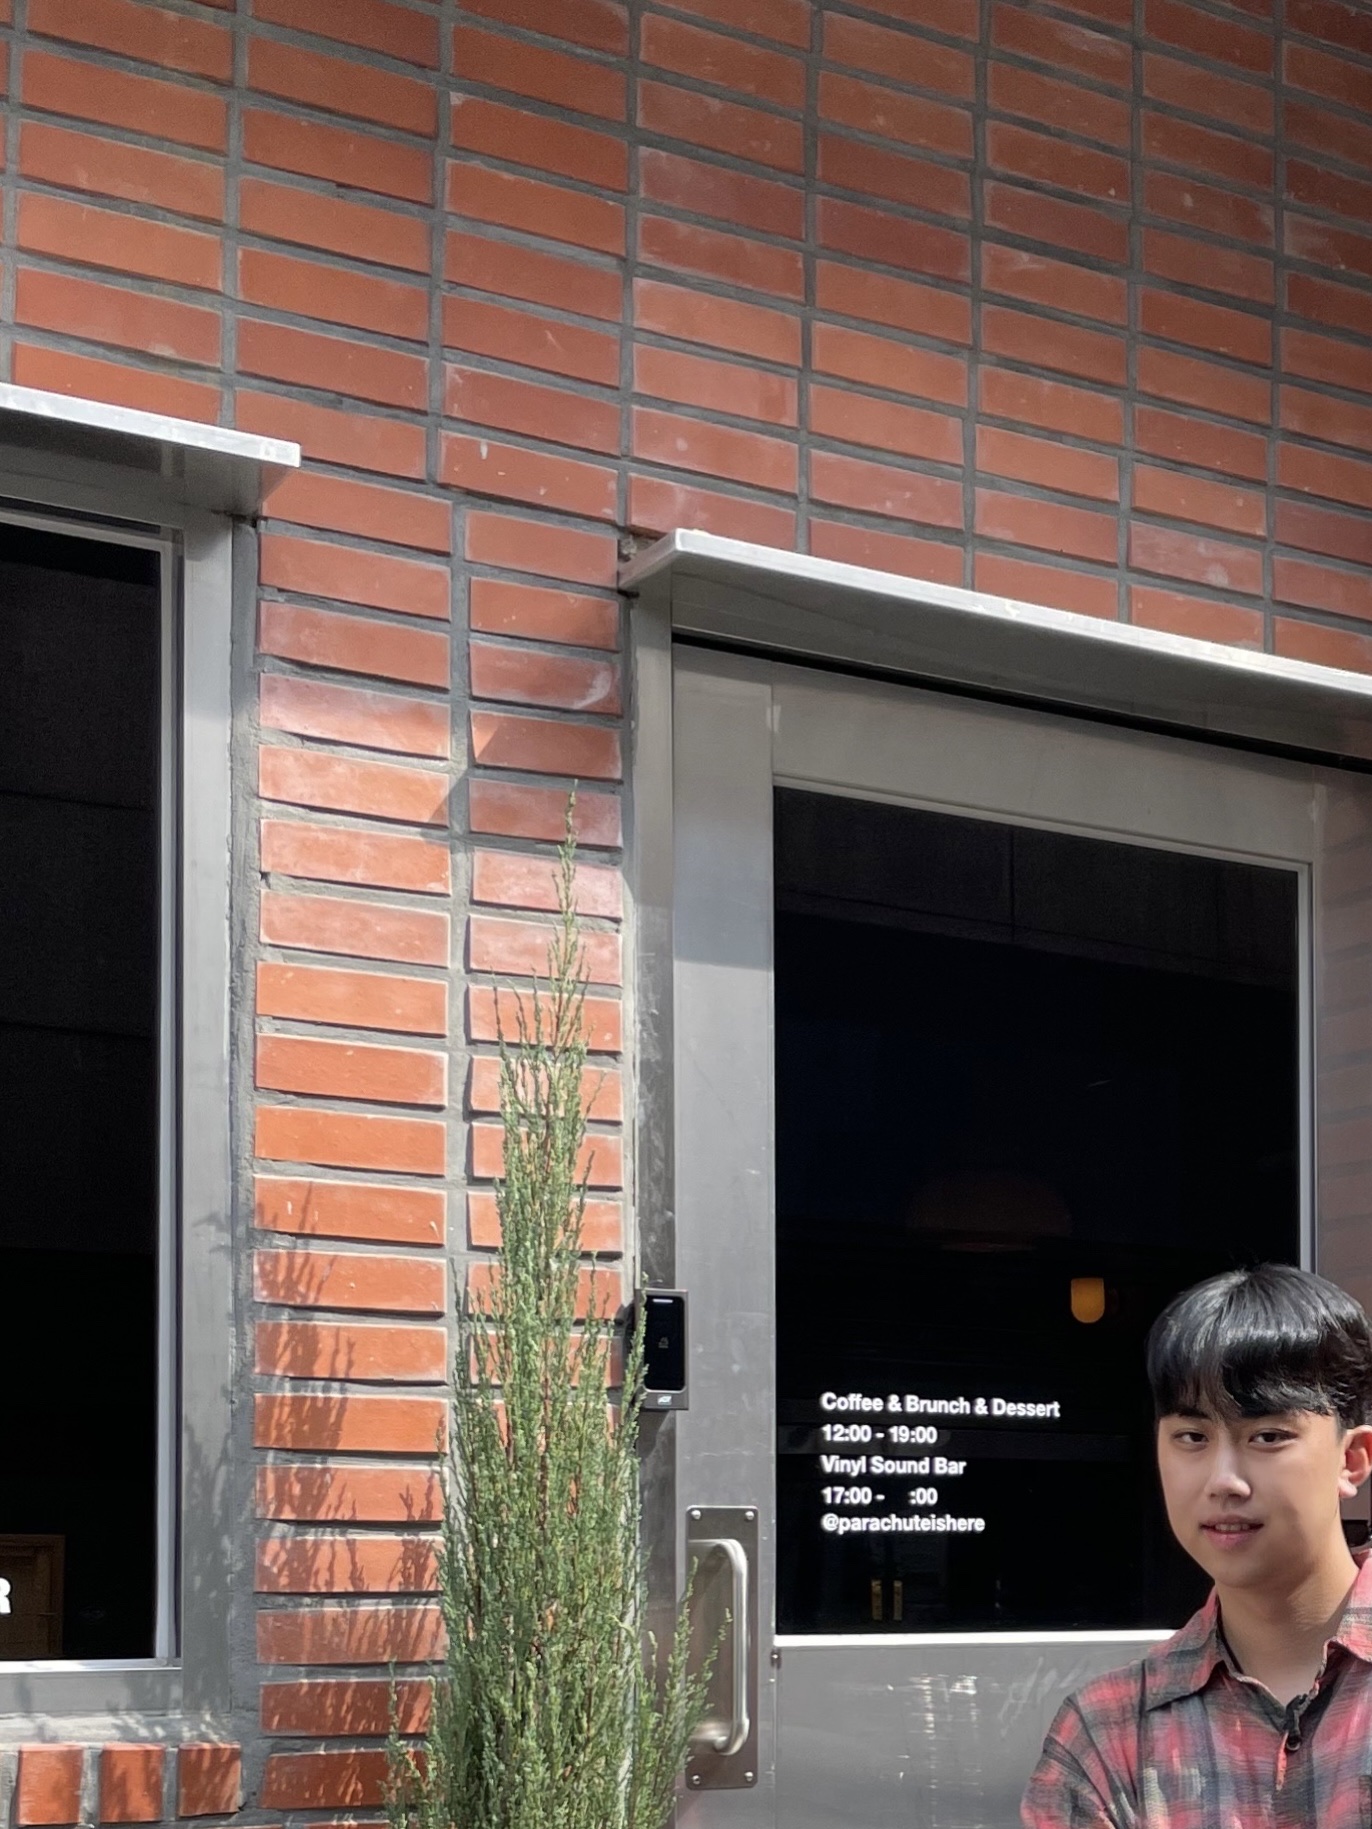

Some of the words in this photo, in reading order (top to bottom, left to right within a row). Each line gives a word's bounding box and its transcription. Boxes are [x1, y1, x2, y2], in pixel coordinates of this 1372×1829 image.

[821, 1392, 884, 1412] Coffee
[887, 1394, 902, 1412] &
[904, 1394, 970, 1414] Brunch
[974, 1397, 989, 1415] &
[992, 1398, 1060, 1418] Dessert
[822, 1424, 872, 1442] 12:00
[889, 1426, 938, 1443] 19:00
[821, 1455, 866, 1476] Vinyl
[870, 1456, 929, 1475] Sound
[933, 1457, 967, 1475] Bar
[822, 1487, 872, 1504] 17:00
[821, 1513, 986, 1535] @parachuteishere
